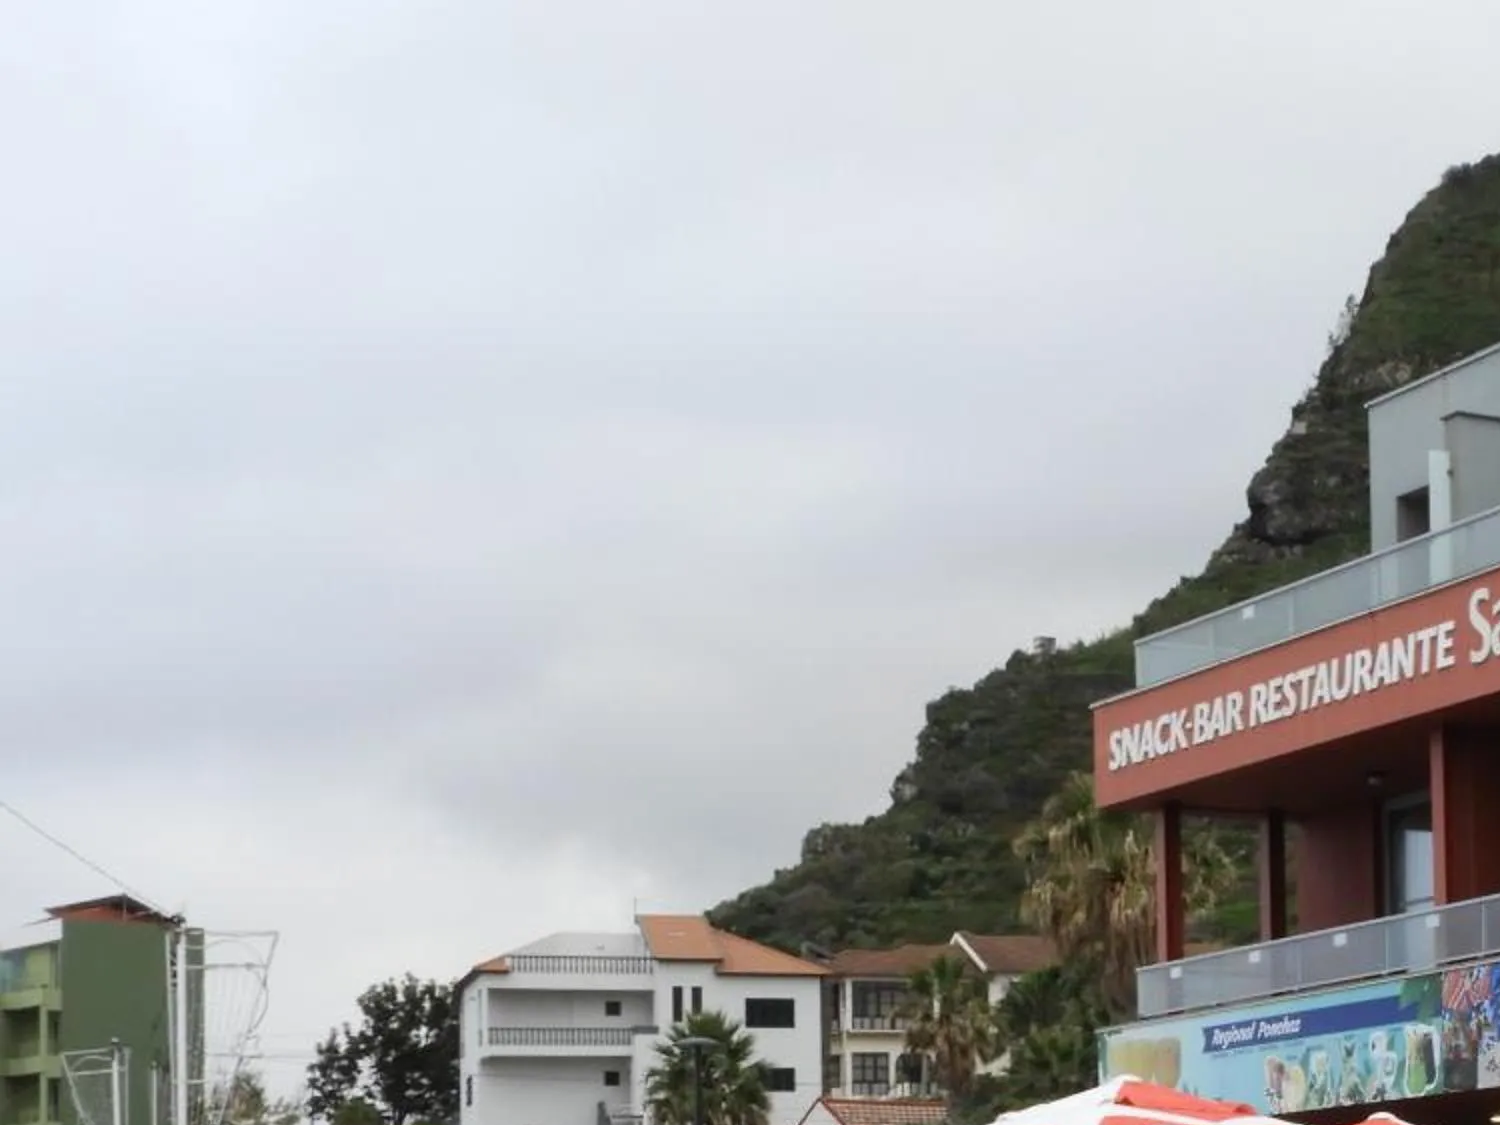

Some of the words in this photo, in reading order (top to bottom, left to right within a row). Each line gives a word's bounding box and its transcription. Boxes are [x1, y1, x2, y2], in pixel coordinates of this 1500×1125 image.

[1108, 691, 1245, 771] SNACK-BAR
[1249, 620, 1456, 728] RESTAURANTE
[1211, 1019, 1256, 1049] Regional
